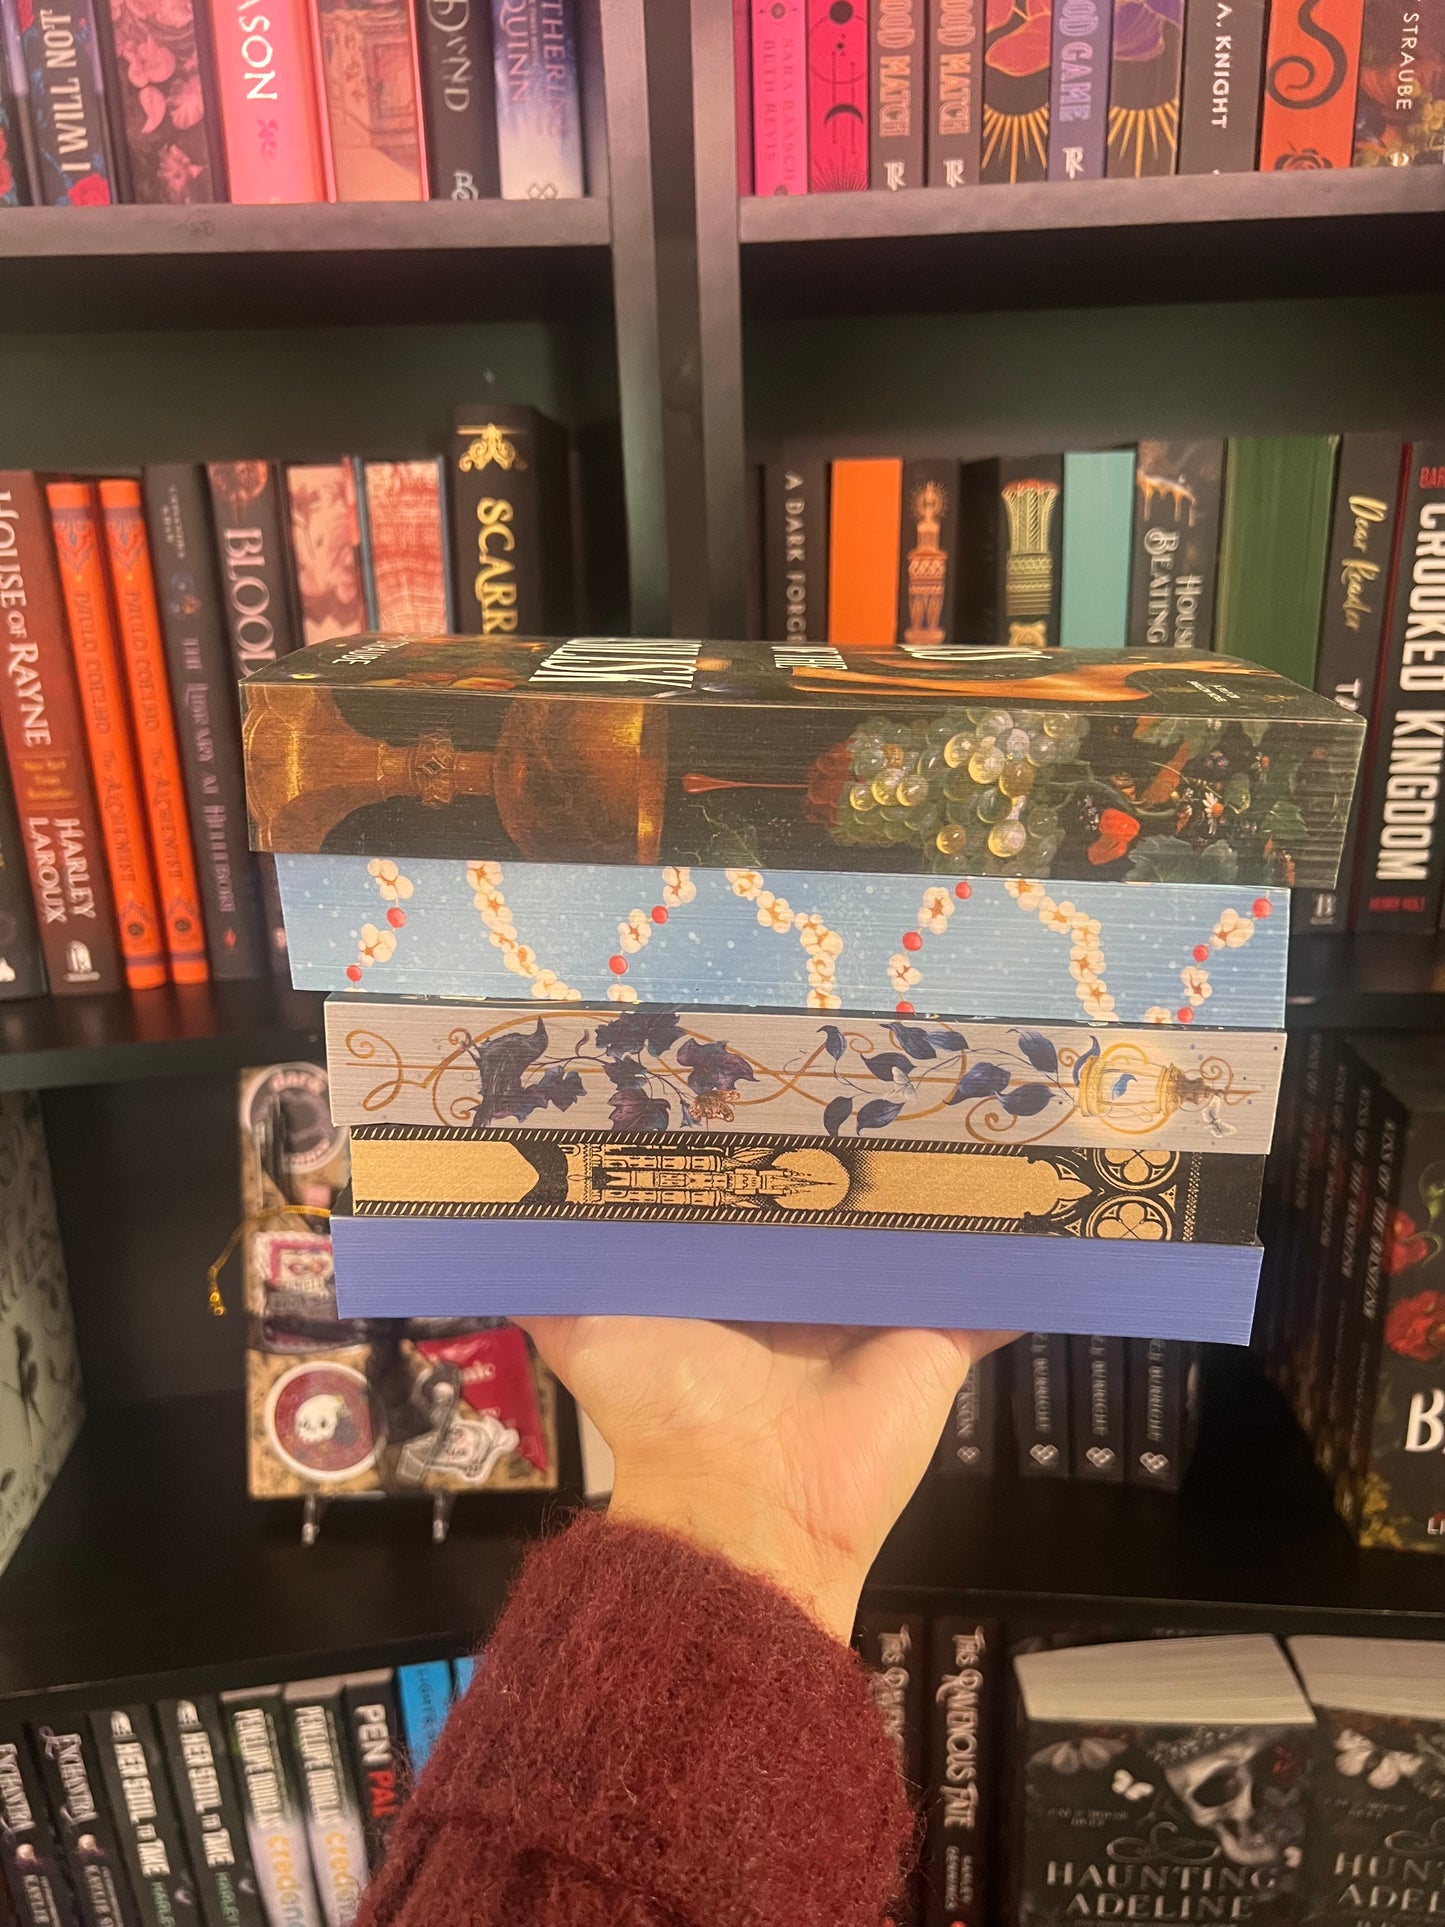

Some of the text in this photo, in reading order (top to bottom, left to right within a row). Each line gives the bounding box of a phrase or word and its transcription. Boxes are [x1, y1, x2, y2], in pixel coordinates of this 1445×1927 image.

[40, 8, 91, 171] I WILL NOT
[879, 55, 911, 137] MATCH
[939, 53, 971, 135] MATCH
[1059, 41, 1093, 122] GAME
[1211, 35, 1231, 128] KNIGHT
[1395, 12, 1420, 110] STRAUBE
[785, 471, 804, 490] A
[475, 496, 519, 635] SCARR
[785, 499, 806, 562] DARK
[1144, 528, 1180, 644] BEATING
[1399, 502, 1445, 692] CROOKED
[8, 642, 52, 747] RAYNE
[185, 683, 214, 762] LIBRARY
[1375, 710, 1445, 881] KINGDOM
[28, 816, 67, 924] LAROUX
[55, 816, 96, 919] HARLEY
[114, 1742, 148, 1779] HER
[180, 1731, 214, 1769] HER
[234, 1707, 275, 1774] PENELOPE
[294, 1705, 335, 1771] PENELOPE
[354, 1703, 400, 1818] PEN PAL
[936, 1668, 985, 1783] RAVENOUS
[122, 1776, 158, 1825] SOUL
[187, 1765, 223, 1814] SOUL
[939, 1780, 980, 1830] FATE
[137, 1838, 172, 1878] TAKE
[202, 1826, 236, 1867] TAKE
[1047, 1860, 1277, 1892] HAUNTING
[1065, 1893, 1255, 1919] ADELINE
